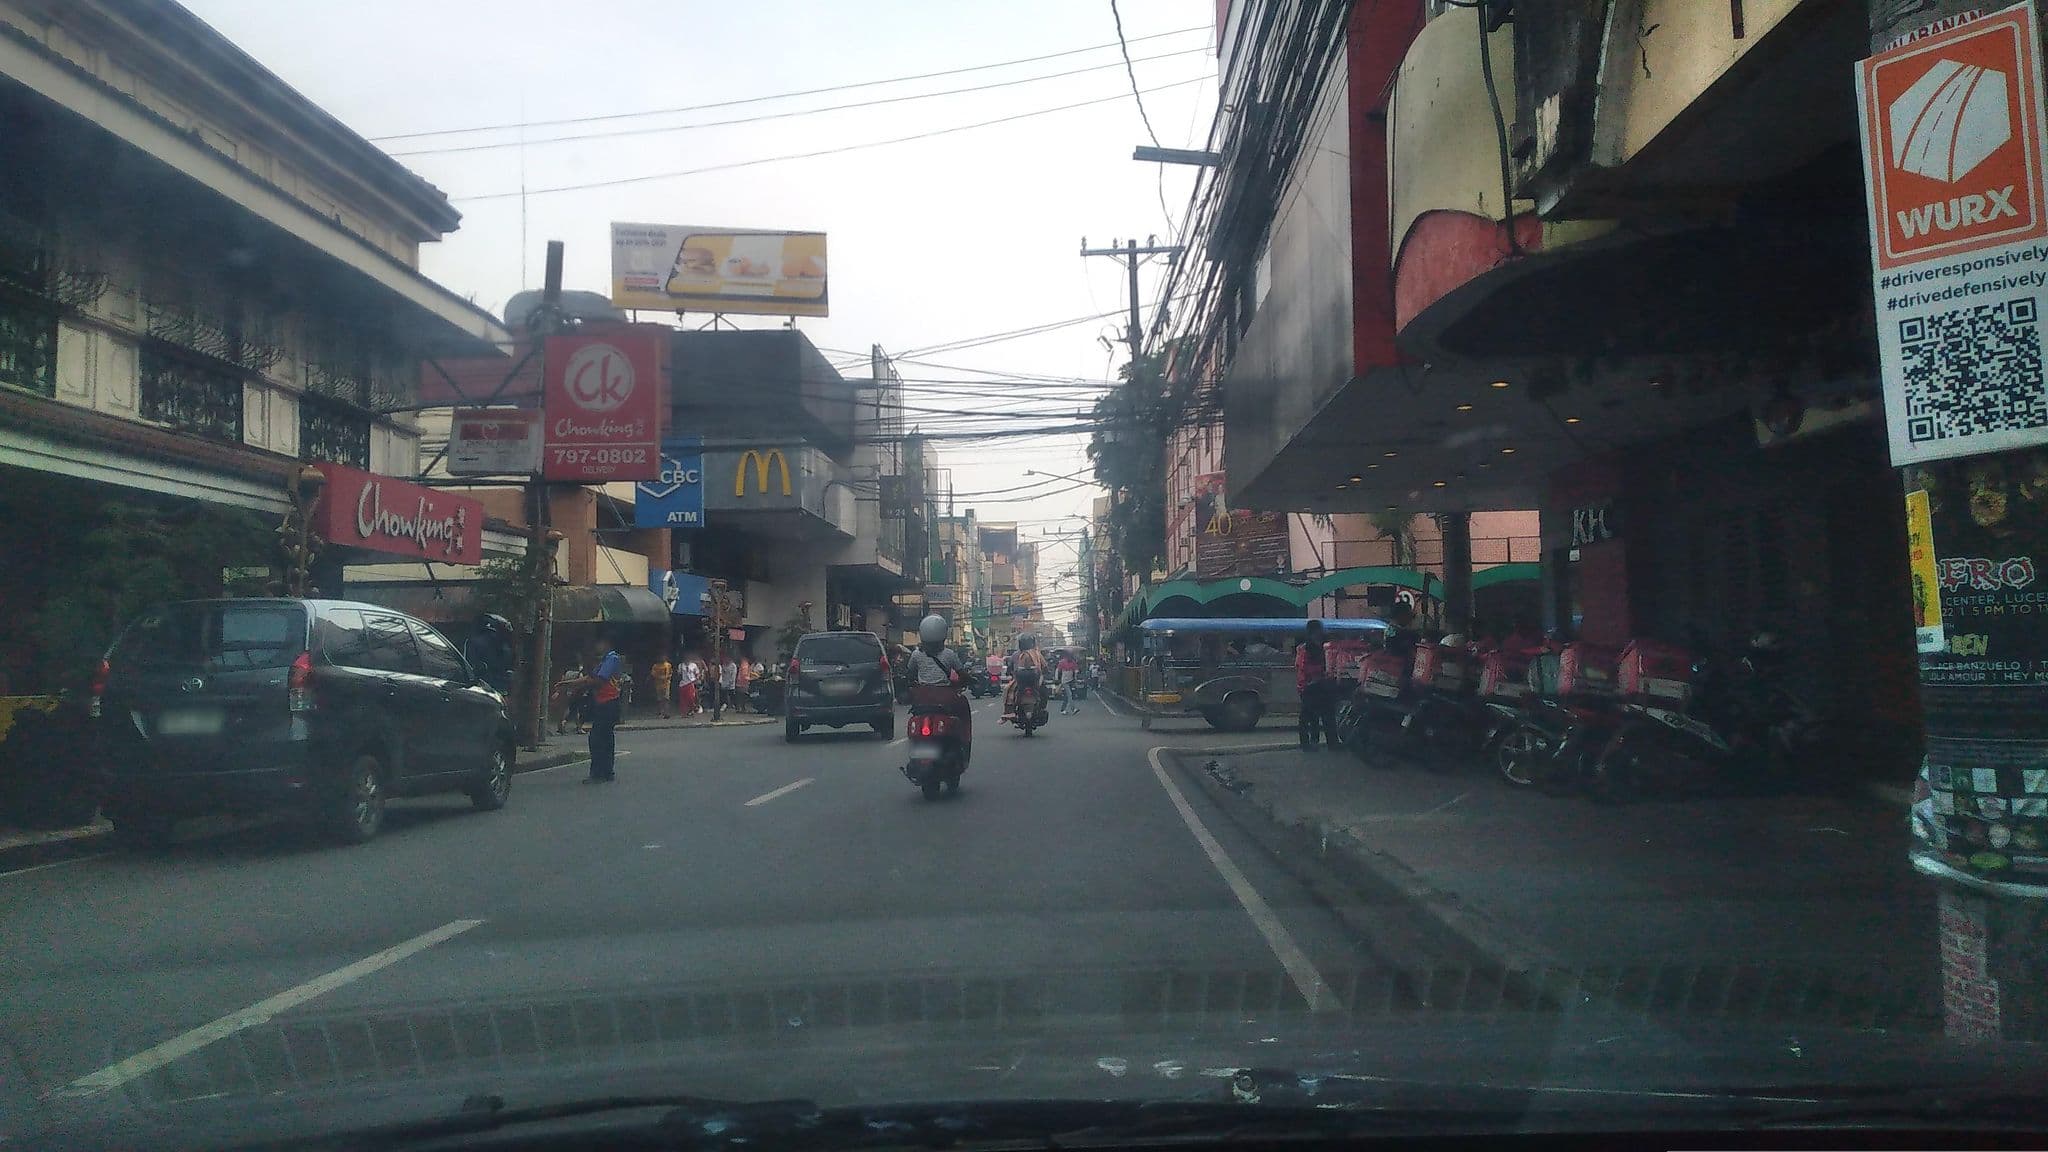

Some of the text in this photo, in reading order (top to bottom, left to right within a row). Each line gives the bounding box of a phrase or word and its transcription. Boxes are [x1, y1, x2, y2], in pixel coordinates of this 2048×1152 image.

[1896, 184, 2018, 239] WURX
[1880, 245, 2048, 290] #driveresponsively
[1887, 270, 2047, 311] #drivedefensively
[555, 418, 633, 438] Chowking
[554, 449, 647, 465] 797-0802
[660, 469, 699, 485] CBC
[358, 479, 454, 554] Chowking
[666, 511, 698, 523] ATM
[1936, 556, 2035, 592] ERO
[2005, 592, 2048, 604] LUCE
[1942, 607, 1954, 617] 22
[1985, 605, 2004, 615] PM
[2011, 604, 2031, 614] TO
[2004, 671, 2029, 681] HEY
